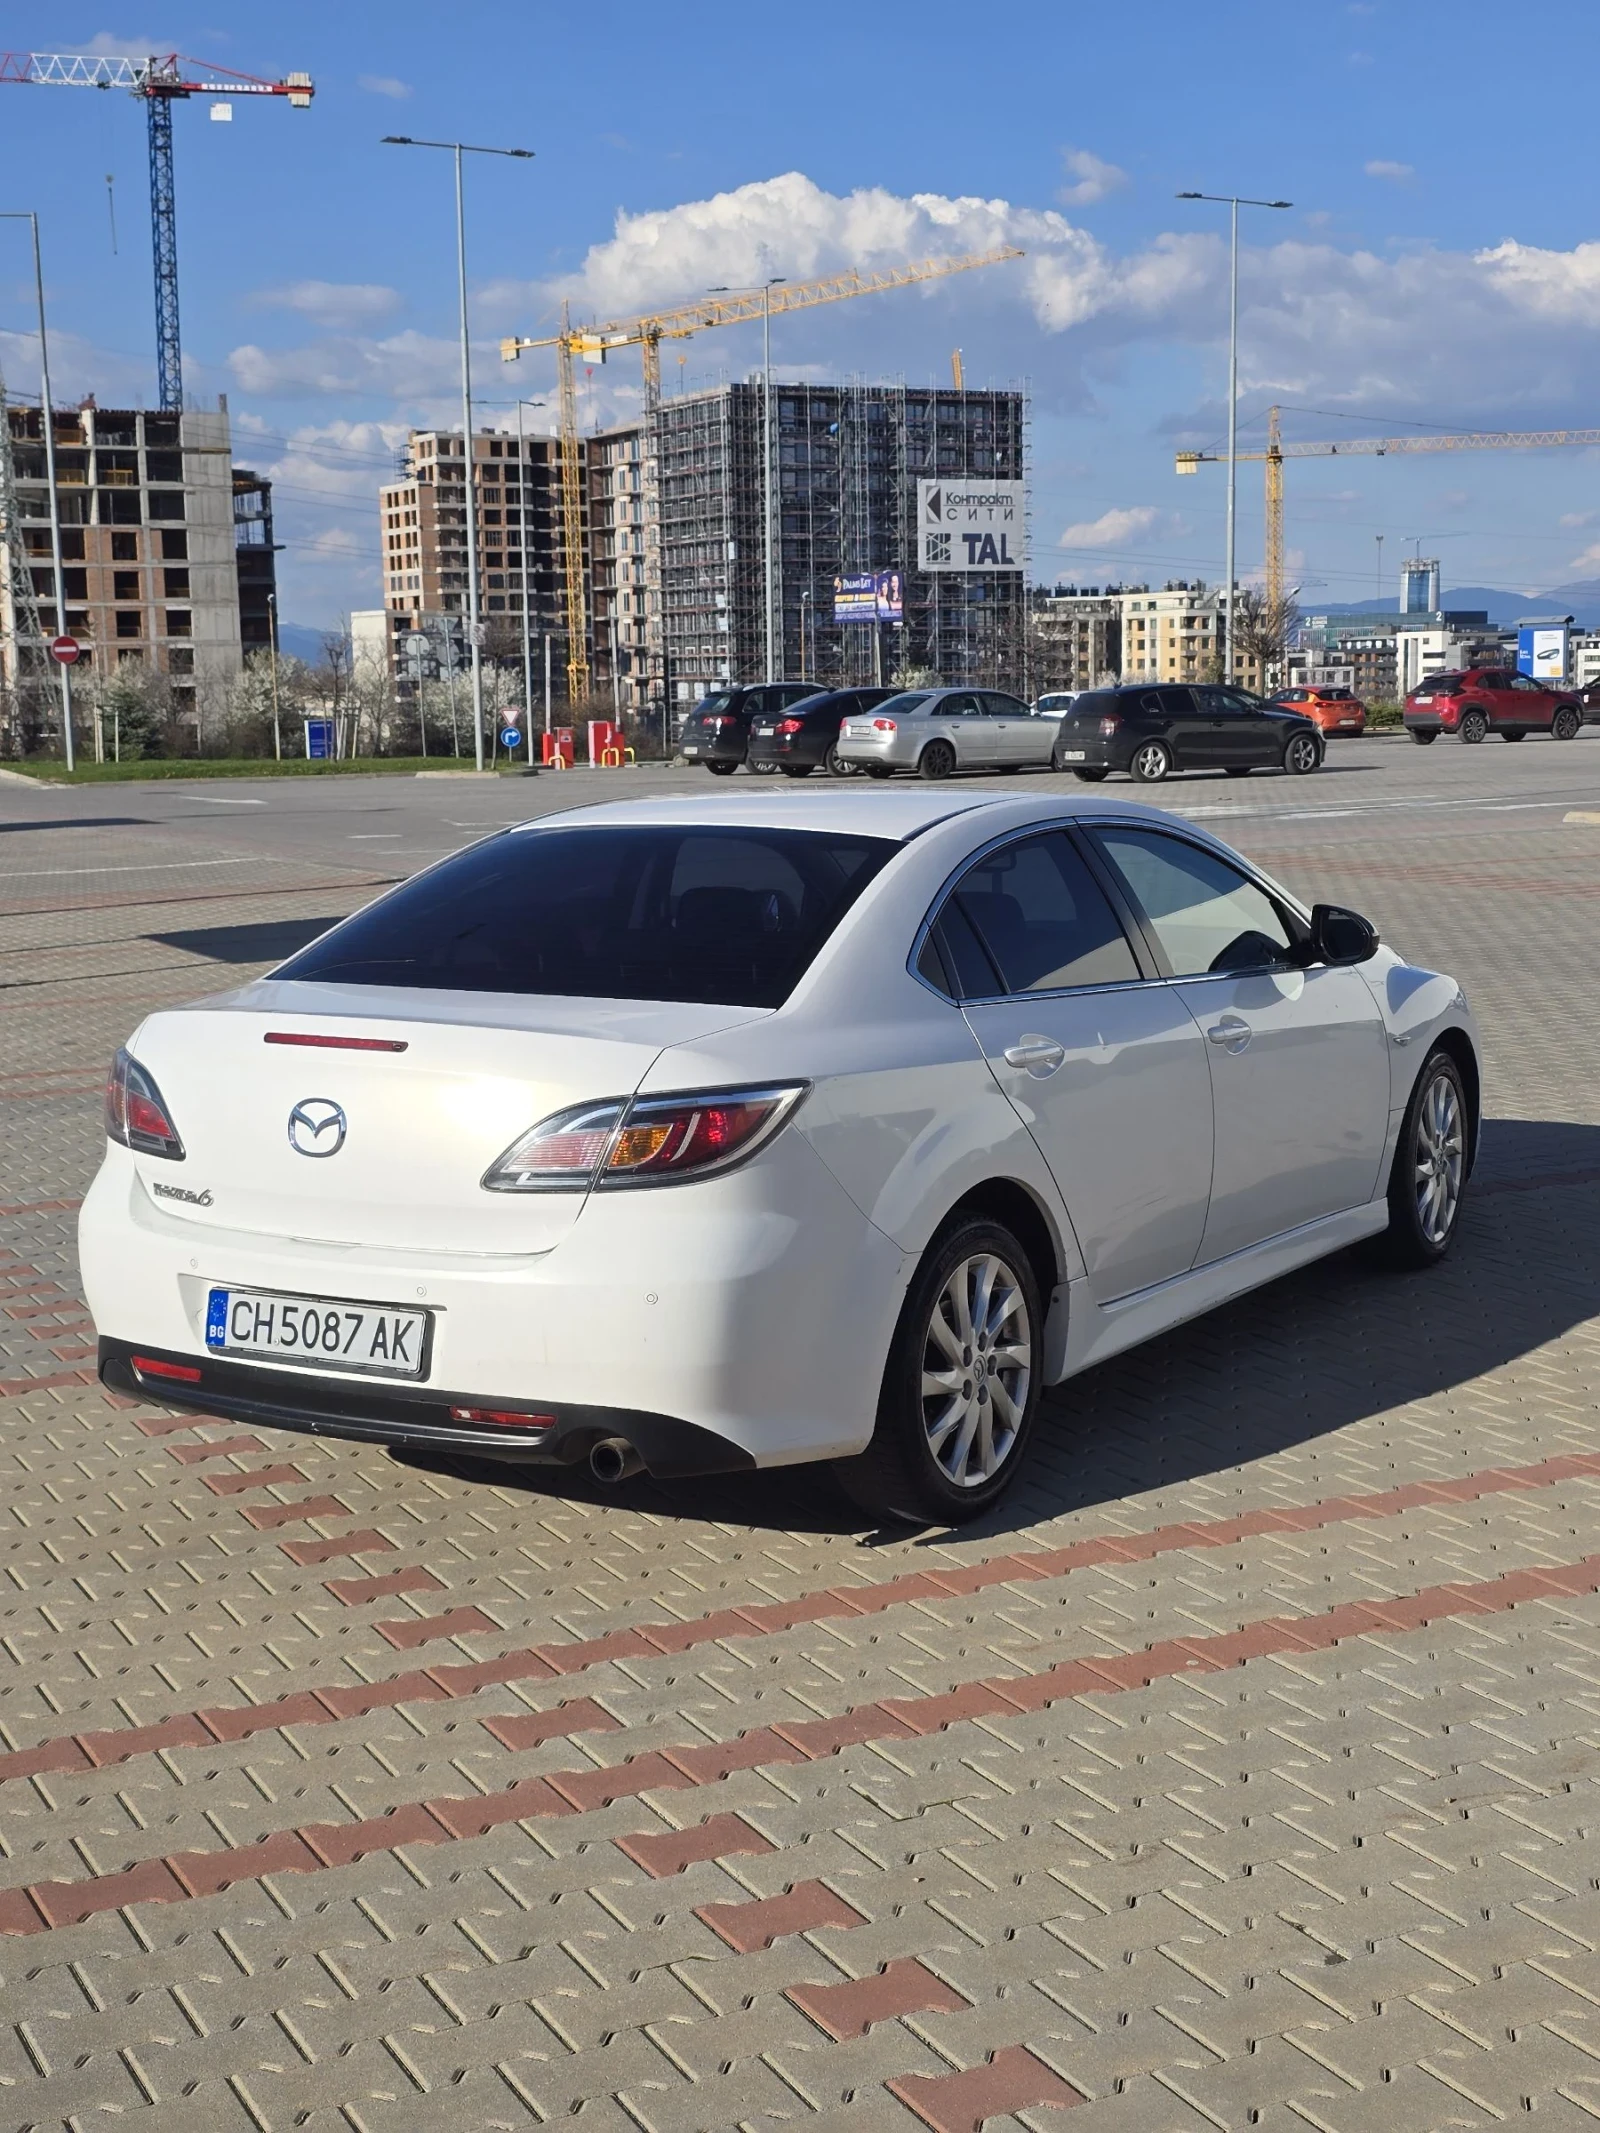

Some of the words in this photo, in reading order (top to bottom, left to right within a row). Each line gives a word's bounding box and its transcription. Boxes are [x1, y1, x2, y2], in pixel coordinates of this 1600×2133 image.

[946, 508, 1013, 521] СИТИ
[962, 533, 1015, 565] TAL
[1305, 617, 1311, 626] 2
[1435, 611, 1442, 621] 2
[209, 1325, 224, 1338] BG
